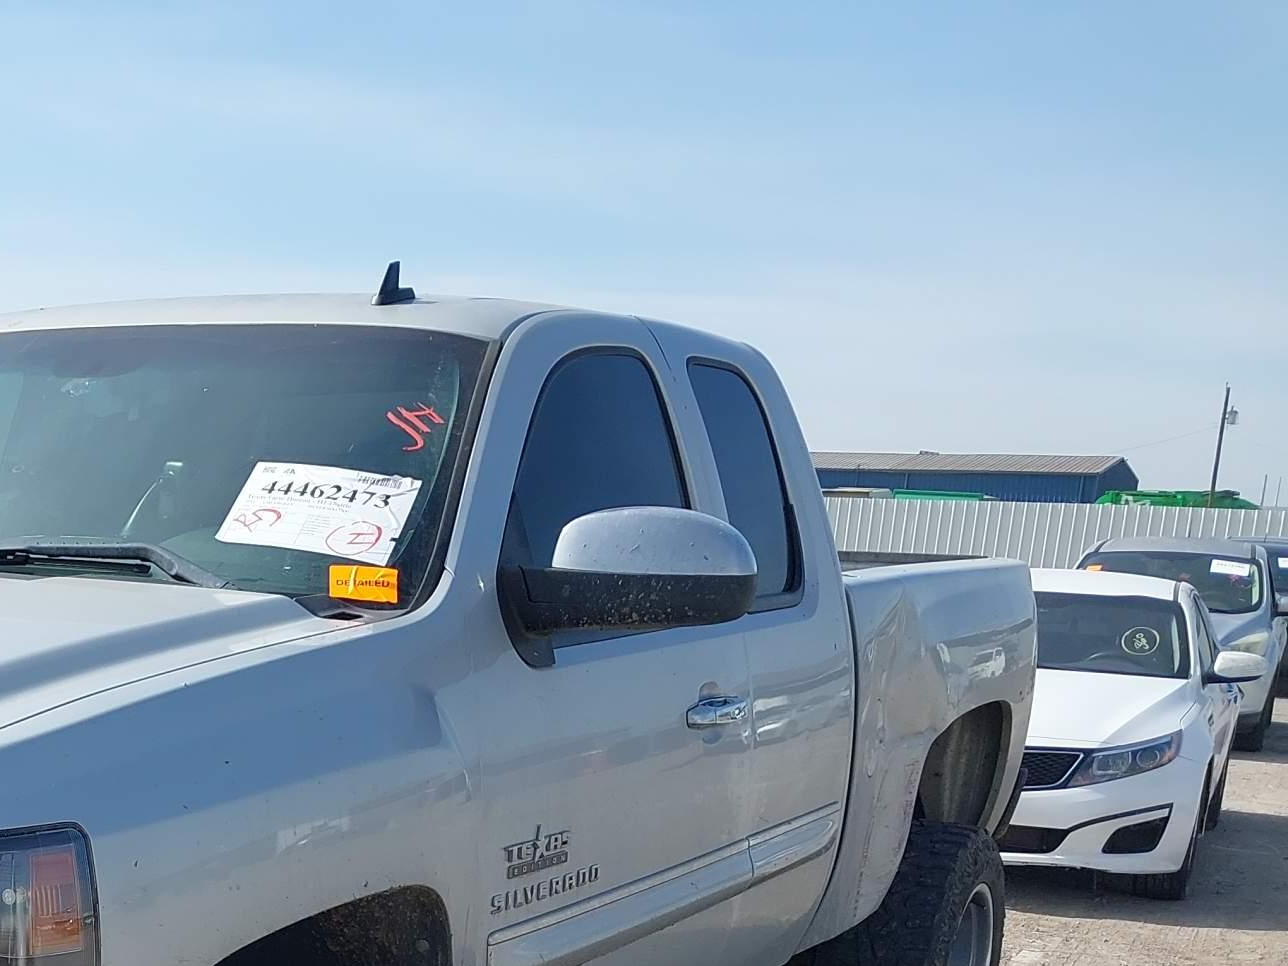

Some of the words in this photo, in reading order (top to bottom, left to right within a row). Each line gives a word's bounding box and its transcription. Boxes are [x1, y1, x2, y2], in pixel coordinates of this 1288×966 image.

[261, 480, 392, 509] 44462473
[503, 824, 569, 863] TEXAS
[512, 852, 567, 877] EDITION
[490, 864, 601, 915] SILVERADO
